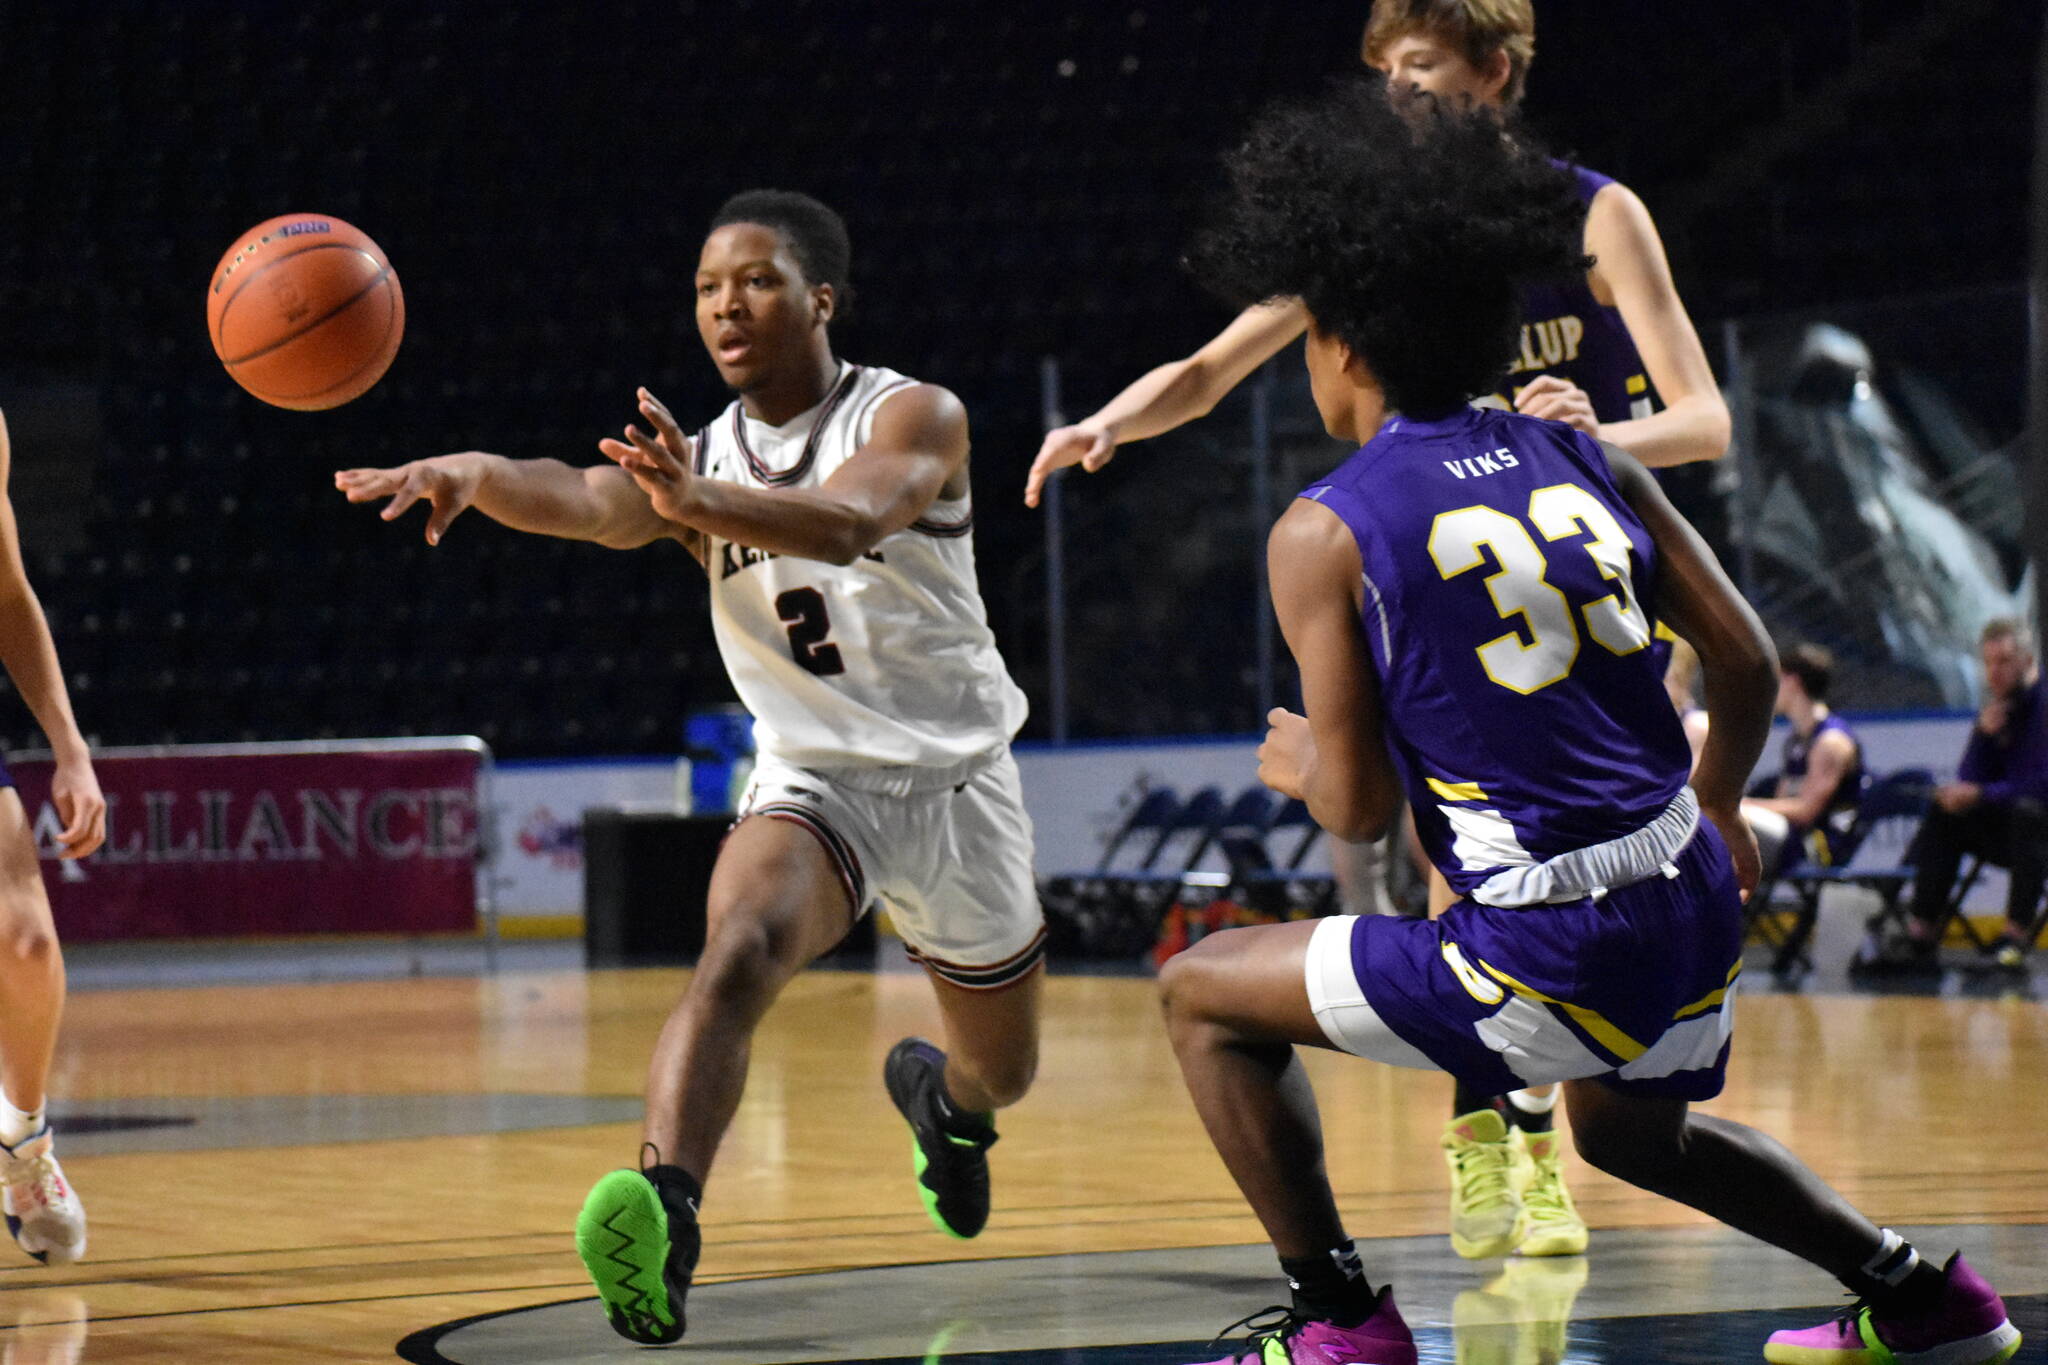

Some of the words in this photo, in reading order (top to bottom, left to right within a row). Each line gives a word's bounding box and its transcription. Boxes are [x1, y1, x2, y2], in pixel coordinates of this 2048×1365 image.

[1507, 315, 1583, 374] LUP
[1444, 448, 1520, 480] VIKS
[1427, 483, 1651, 696] 33
[775, 586, 846, 676] 2
